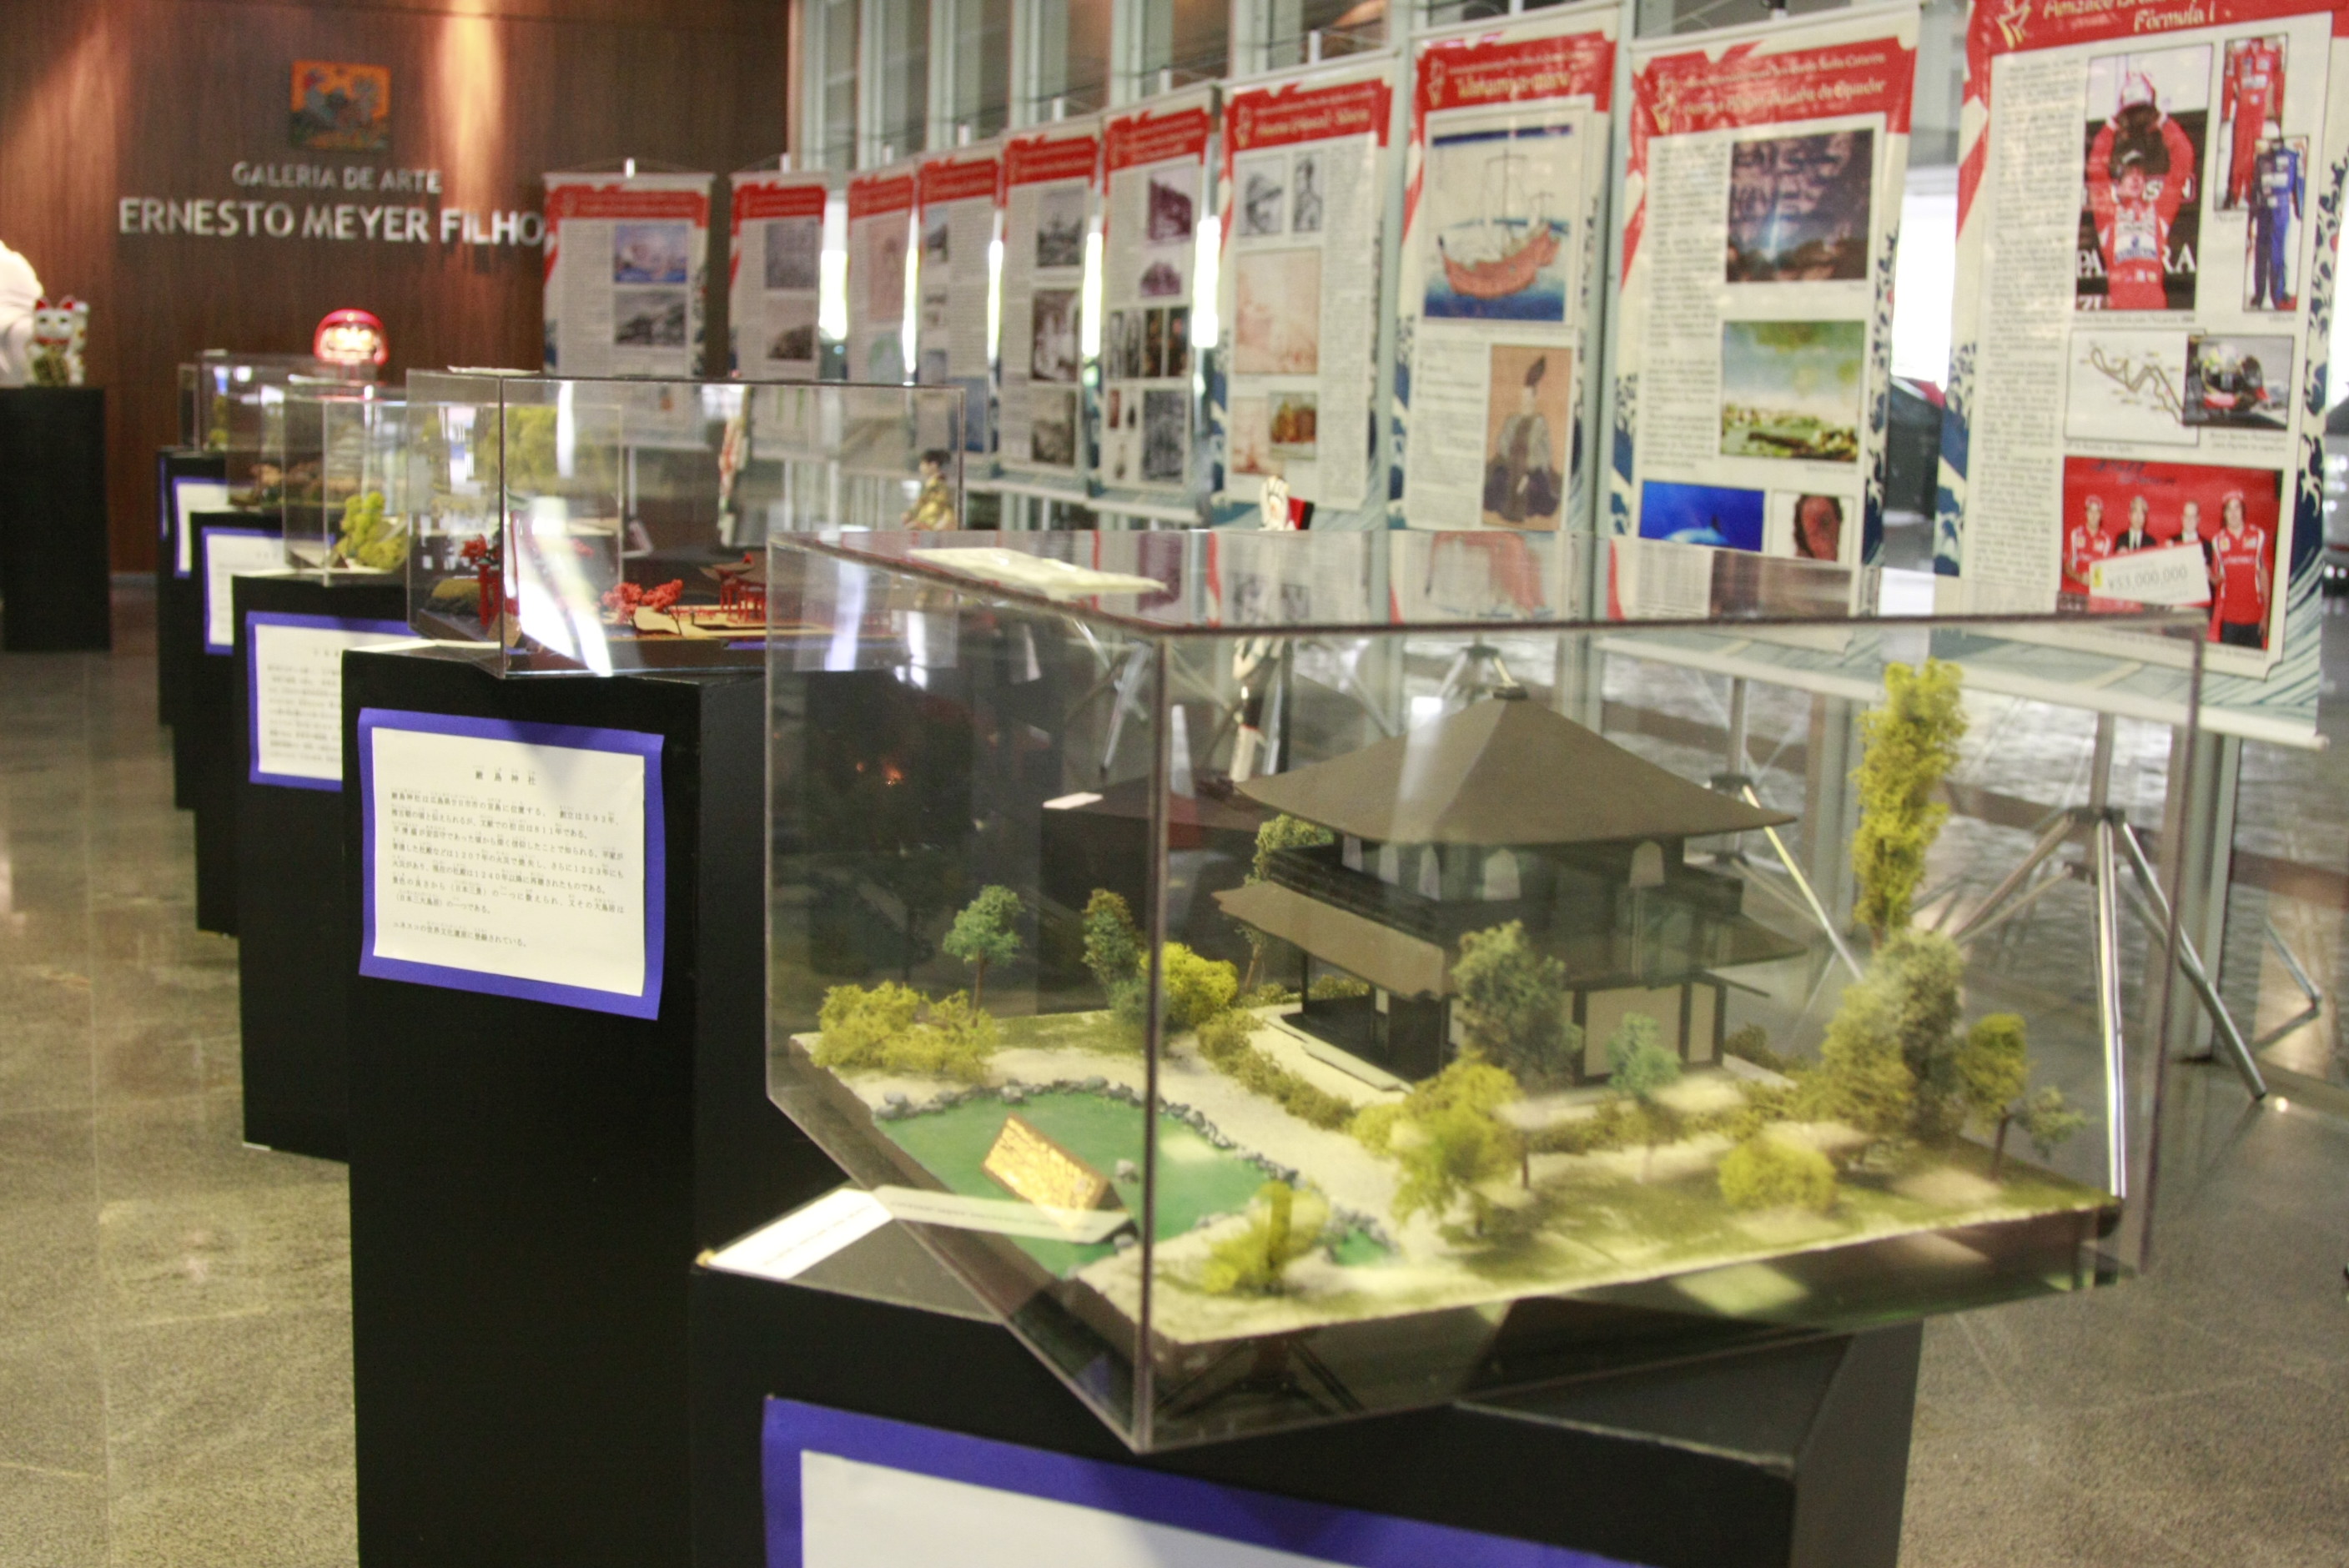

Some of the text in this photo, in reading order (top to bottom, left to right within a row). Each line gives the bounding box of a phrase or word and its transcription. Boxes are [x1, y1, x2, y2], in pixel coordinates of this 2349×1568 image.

[232, 161, 443, 194] GALERIA DE ARTE
[118, 197, 544, 247] ERNESTO MEYER FILHO
